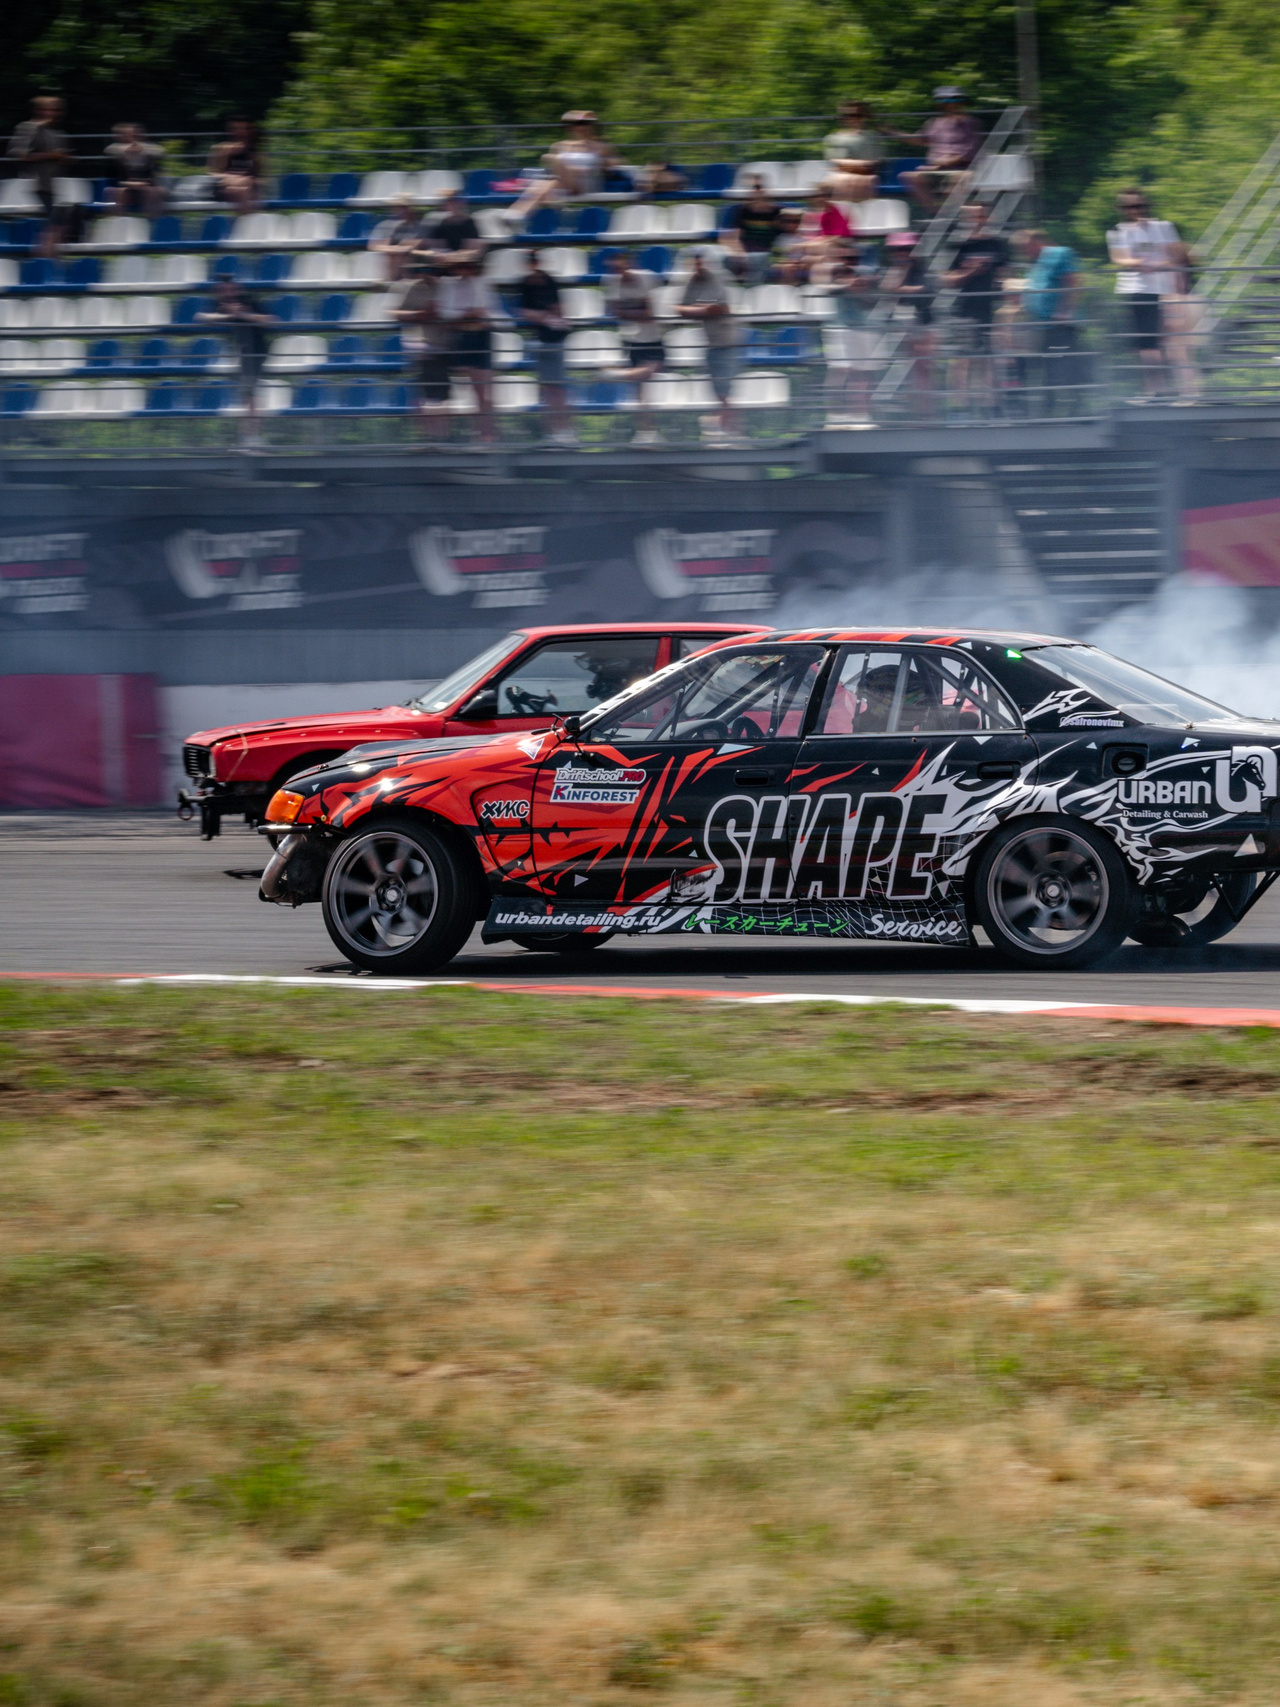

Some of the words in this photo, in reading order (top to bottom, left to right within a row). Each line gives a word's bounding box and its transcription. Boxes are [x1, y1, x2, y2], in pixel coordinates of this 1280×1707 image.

[553, 785, 638, 802] KINFOREST
[1118, 780, 1212, 804] URBAN
[1122, 810, 1162, 819] Detailing
[1164, 810, 1171, 818] &
[1173, 810, 1208, 819] Carwash
[704, 792, 948, 905] SHAPE
[495, 912, 662, 928] urbandetailing.ru
[685, 914, 850, 933] レースカーチューン
[864, 914, 963, 938] Service
